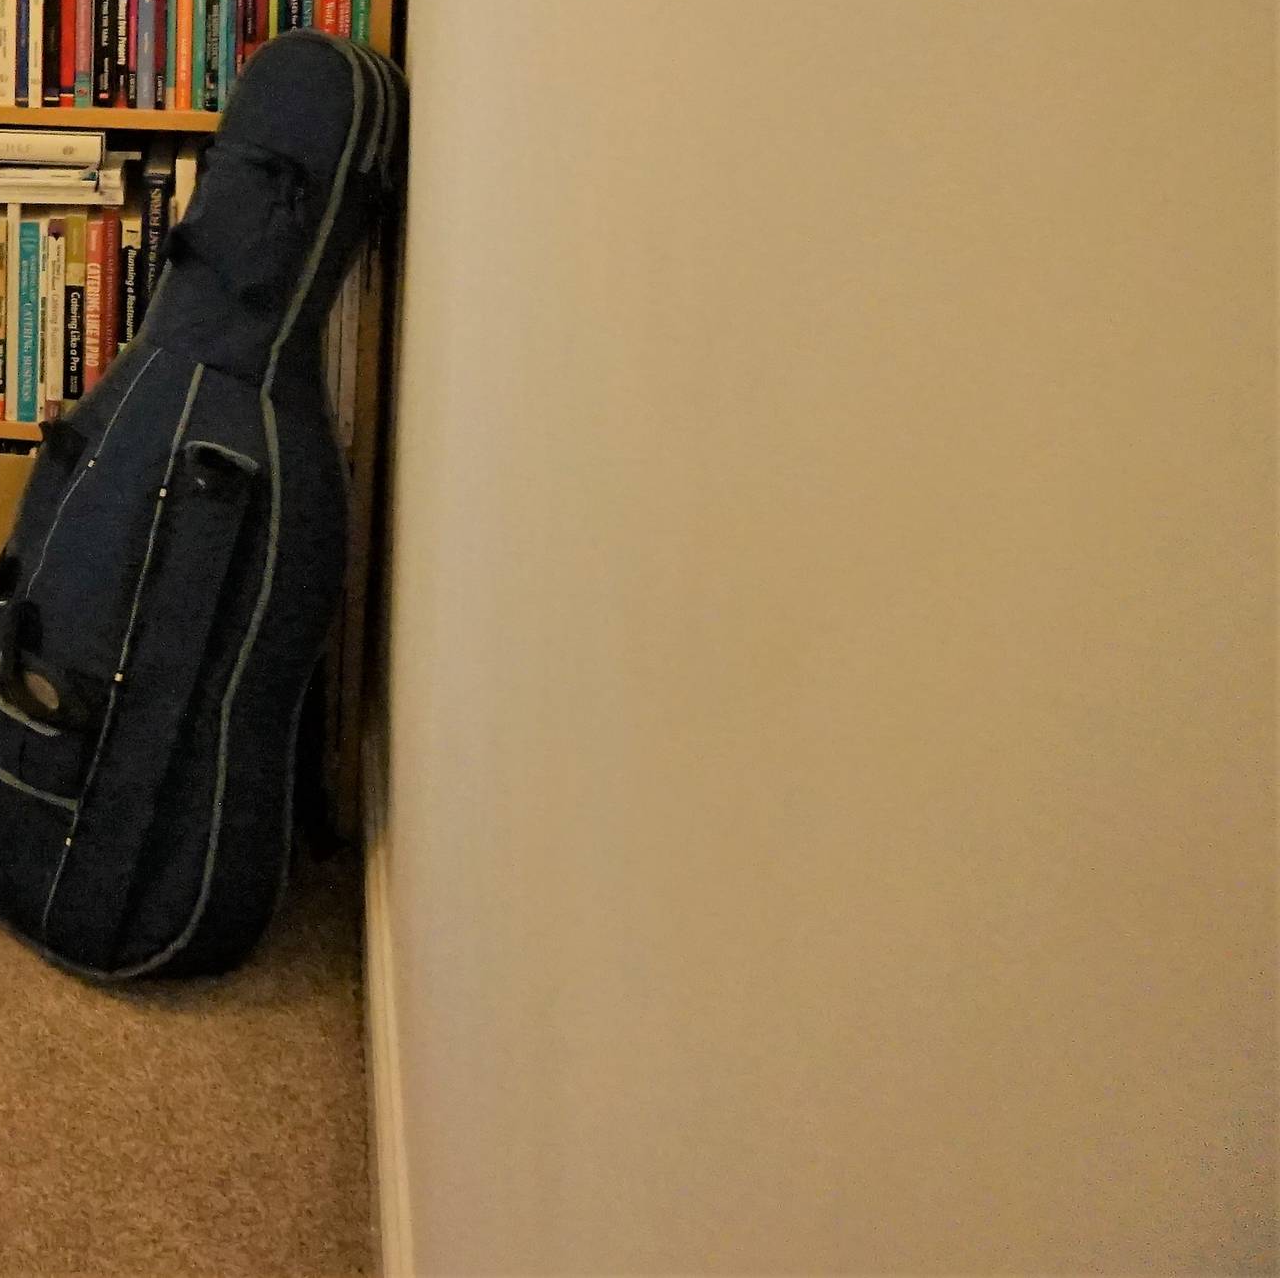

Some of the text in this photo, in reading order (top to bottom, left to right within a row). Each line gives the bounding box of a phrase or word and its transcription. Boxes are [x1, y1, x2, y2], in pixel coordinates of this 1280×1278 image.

[325, 2, 335, 25] Work
[125, 249, 136, 286] Running
[87, 262, 100, 313] CATERING
[68, 292, 80, 329] Catering
[87, 314, 100, 335] LIKE
[69, 330, 80, 348] Like
[69, 357, 80, 372] Pro
